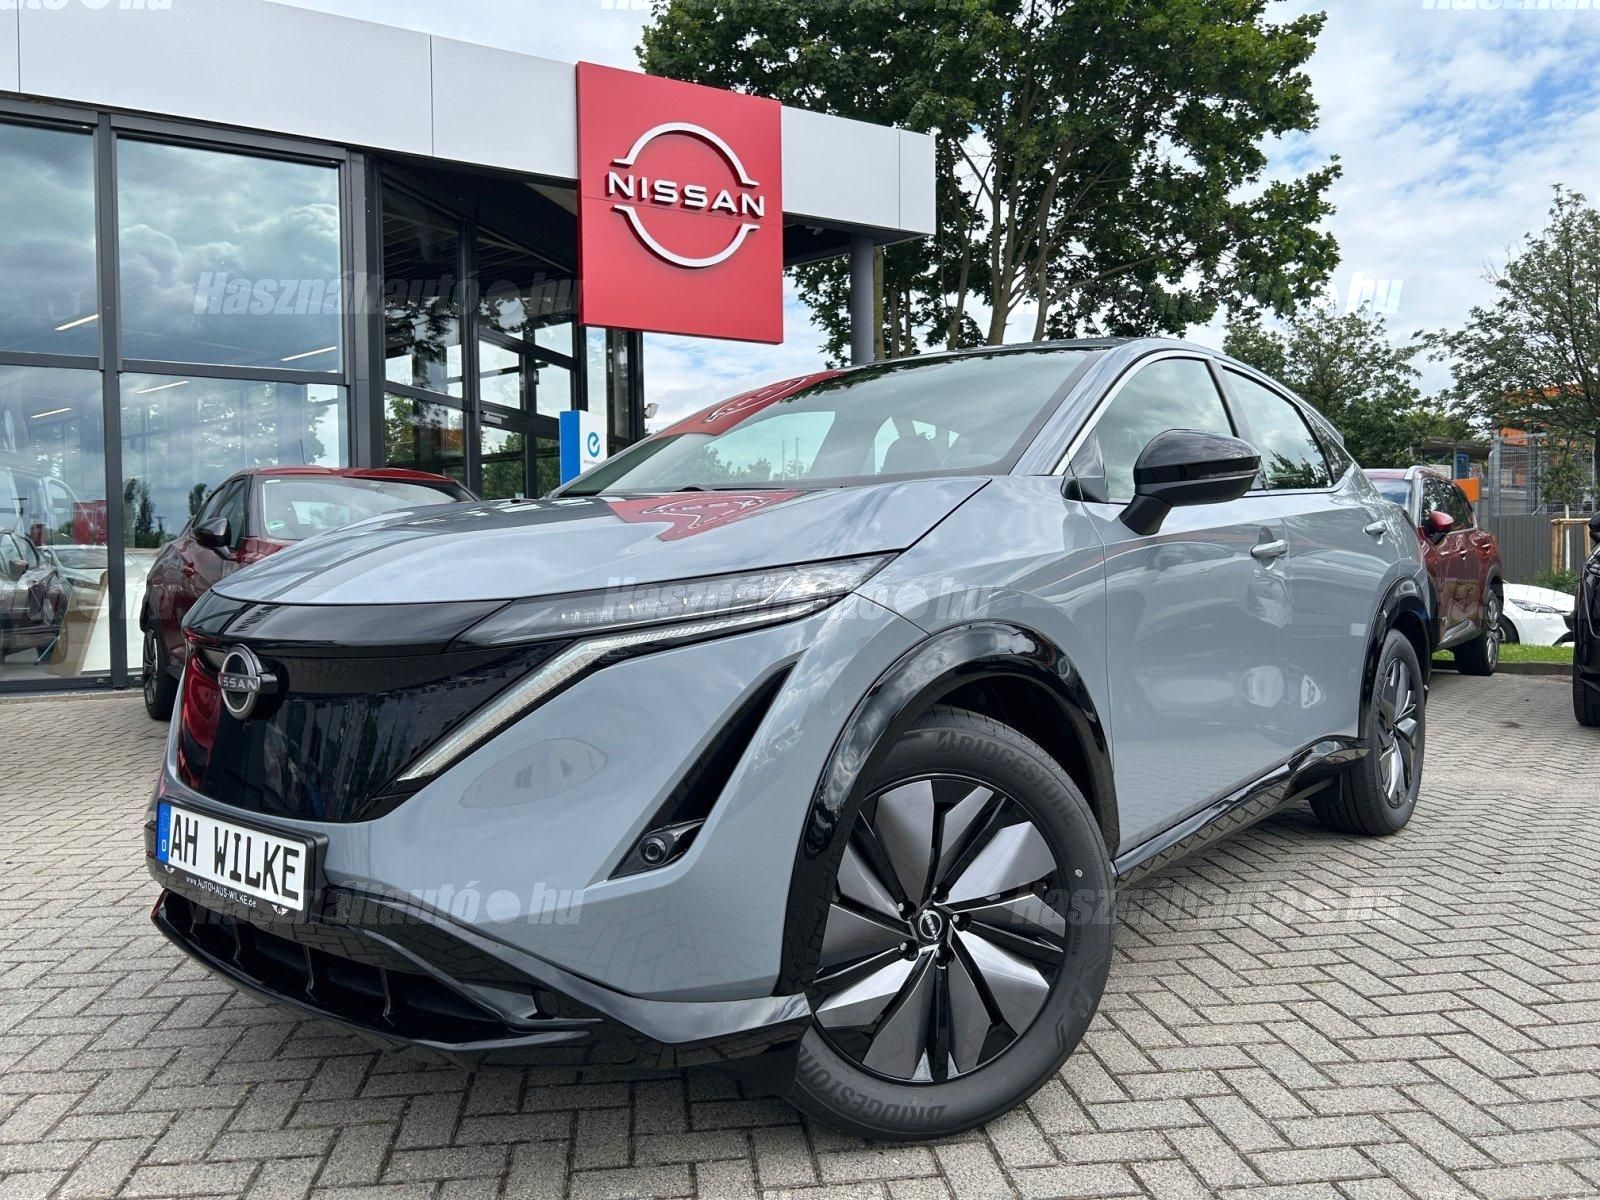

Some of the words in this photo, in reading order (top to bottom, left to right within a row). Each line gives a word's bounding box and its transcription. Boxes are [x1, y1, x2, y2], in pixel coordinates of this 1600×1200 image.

[607, 171, 766, 217] NISSAN
[218, 675, 257, 691] SSAN
[161, 839, 167, 852] D
[170, 814, 199, 867] AH
[213, 826, 300, 901] WILKE
[185, 876, 257, 908] www.AUTOHAUS-WILKE.de
